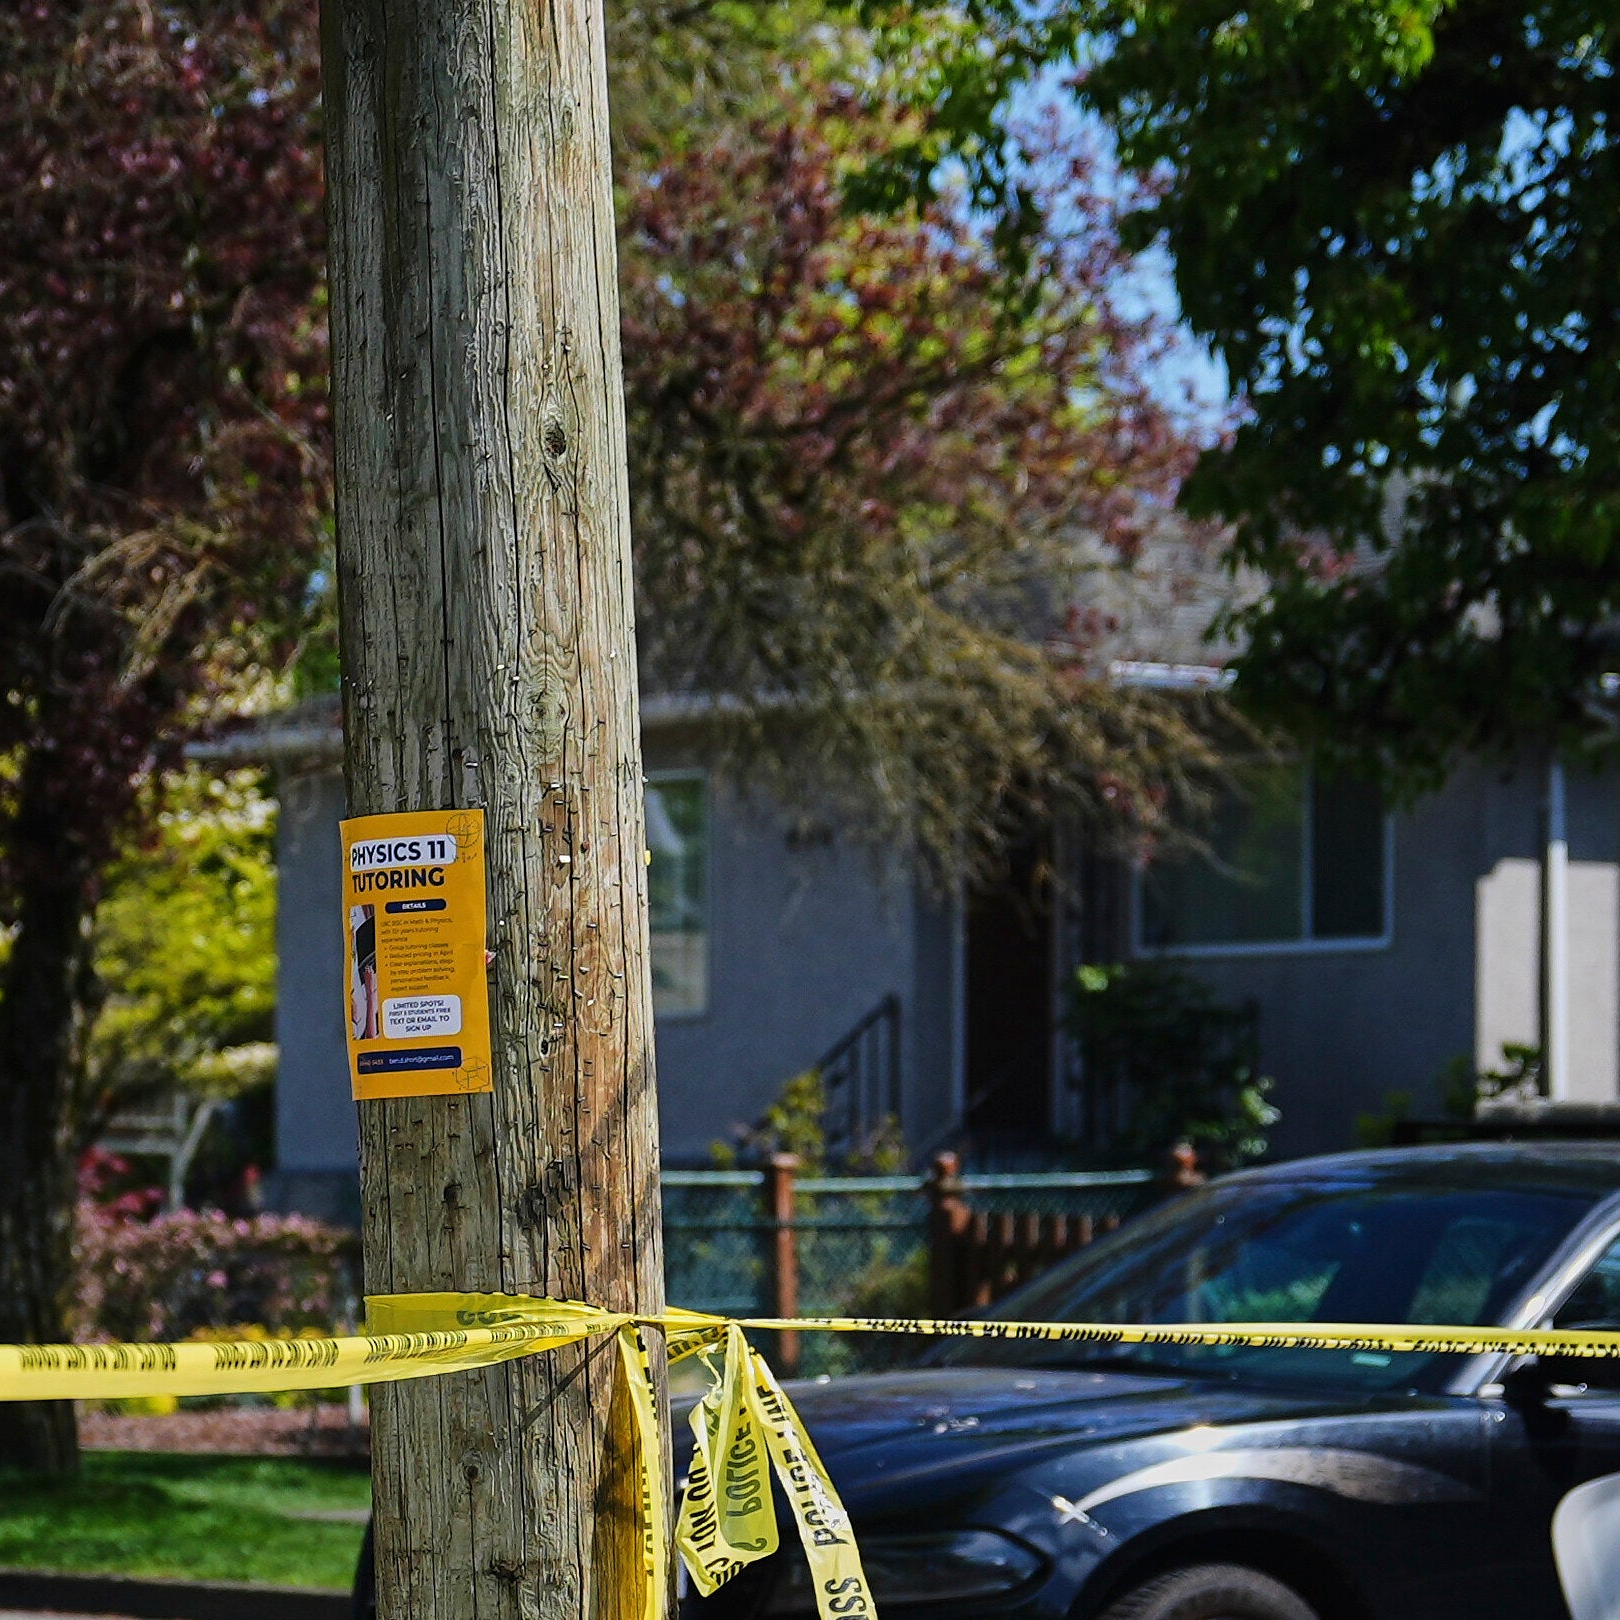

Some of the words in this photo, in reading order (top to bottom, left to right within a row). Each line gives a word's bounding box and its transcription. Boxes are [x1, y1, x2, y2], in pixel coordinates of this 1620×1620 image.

[352, 841, 421, 867] PHYSICS
[427, 840, 446, 859] 11
[352, 867, 444, 893] TUTORING
[393, 1001, 418, 1010] LIMITED
[390, 1018, 404, 1026] TEXT
